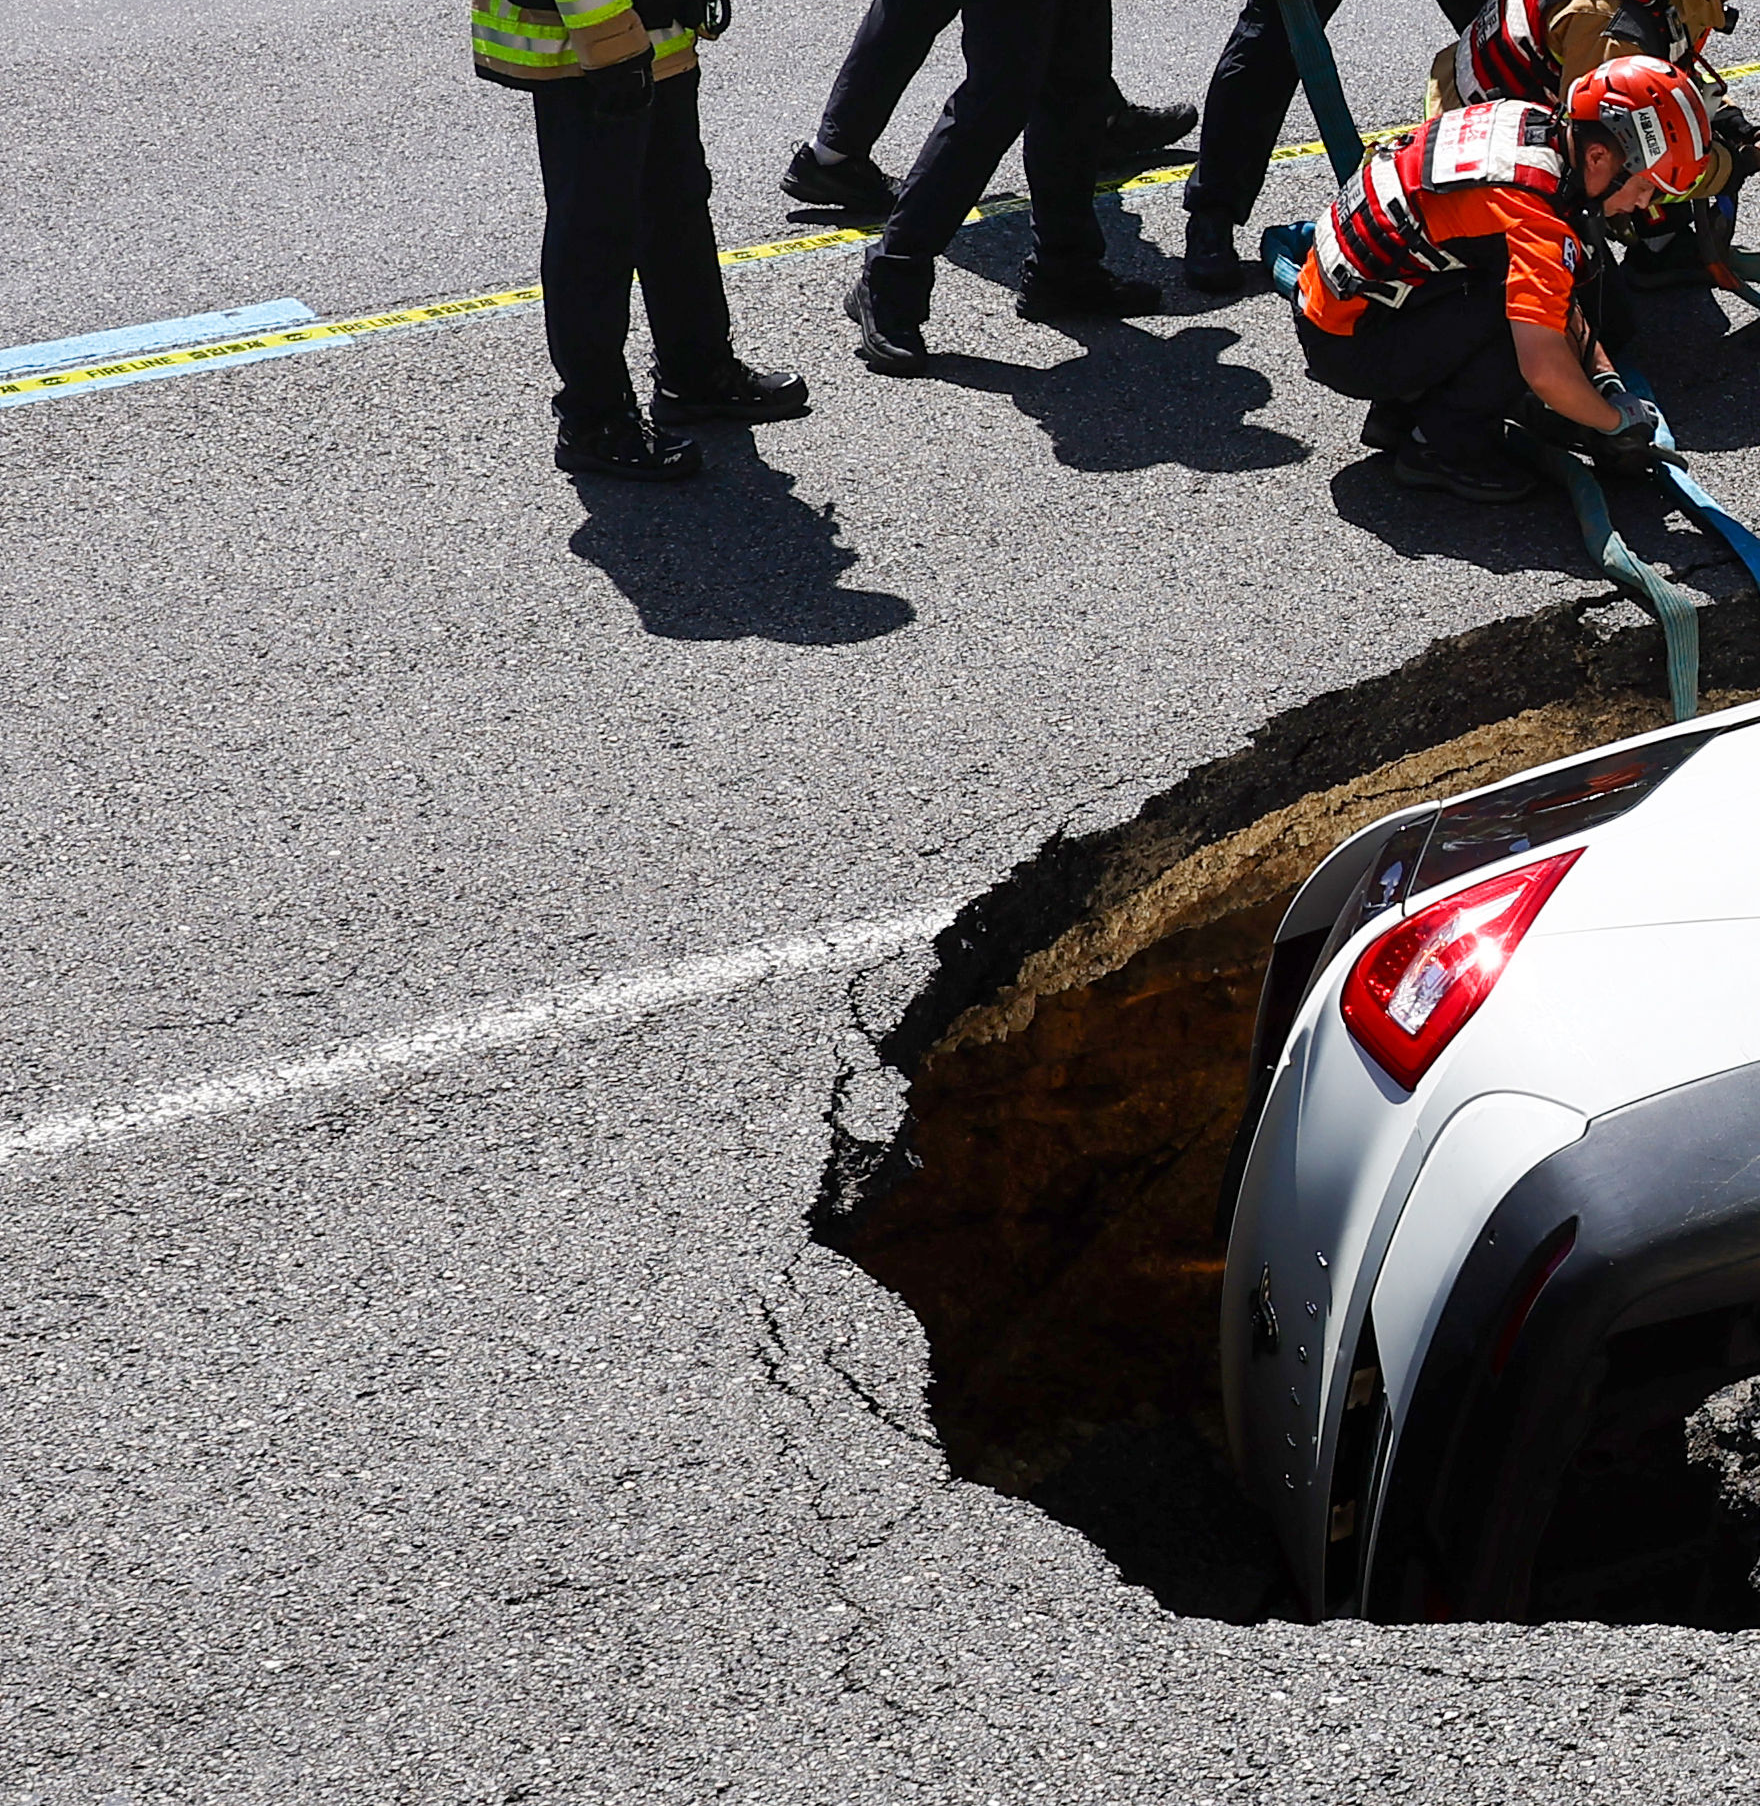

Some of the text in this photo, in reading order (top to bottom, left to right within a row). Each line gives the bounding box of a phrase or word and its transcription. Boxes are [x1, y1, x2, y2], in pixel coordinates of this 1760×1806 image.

[326, 321, 366, 336] FIRE
[369, 314, 413, 331] LINE
[86, 364, 130, 380] FIRE
[132, 356, 173, 371] LINE
